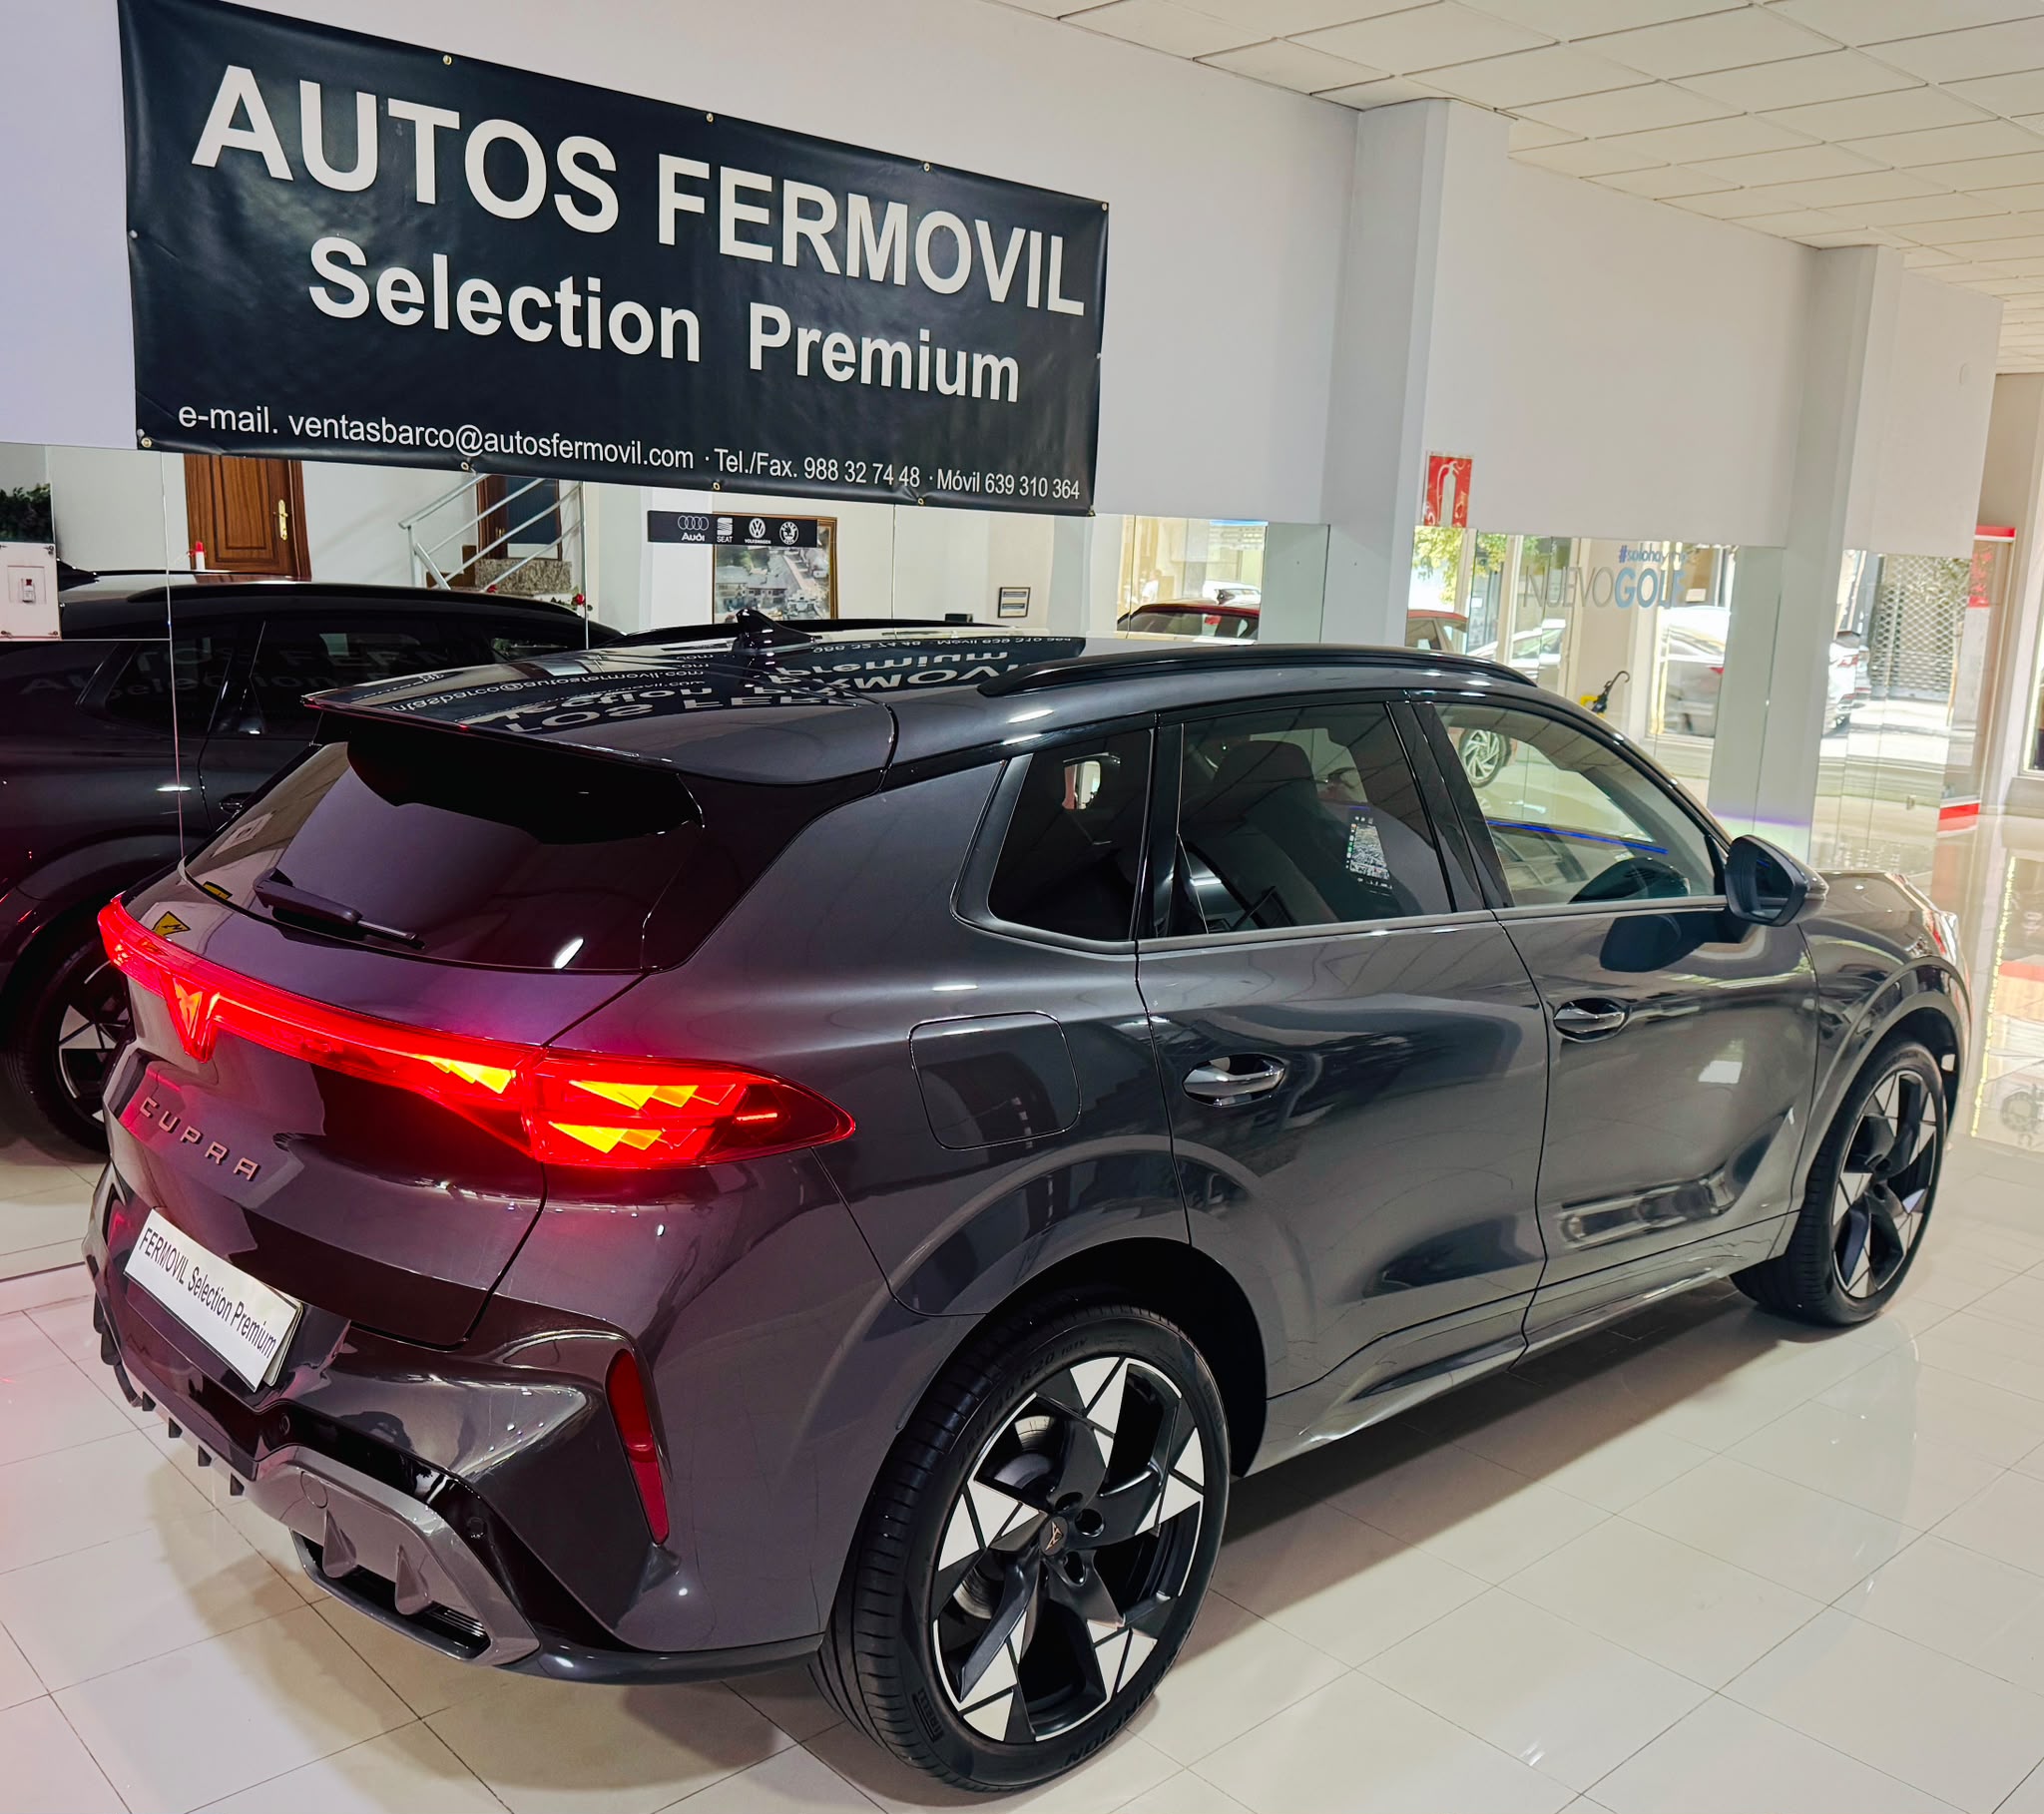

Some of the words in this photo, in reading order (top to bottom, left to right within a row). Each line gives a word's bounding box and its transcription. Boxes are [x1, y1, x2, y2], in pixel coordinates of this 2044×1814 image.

[192, 64, 619, 233] AUTOS
[659, 153, 1085, 316] FERMOVIL
[308, 235, 700, 362] Selection
[750, 301, 1019, 403] Premium
[179, 405, 278, 434] e-mail.
[287, 414, 694, 469] ventasbarco@autosfermovil.com
[714, 448, 797, 478] Tel./Fax.
[803, 456, 839, 481] 988
[844, 460, 867, 483] 32
[872, 463, 894, 486] 74
[900, 466, 920, 488] 48
[937, 468, 980, 493] Móvil
[984, 472, 1015, 495] 639
[1019, 475, 1048, 498] 310
[1052, 478, 1081, 500] 364
[681, 532, 706, 542] Audi
[139, 1095, 260, 1181] CUPRA
[139, 1226, 186, 1286] FERMOVIL
[187, 1266, 233, 1324] Selection
[230, 1300, 277, 1360] Premium
